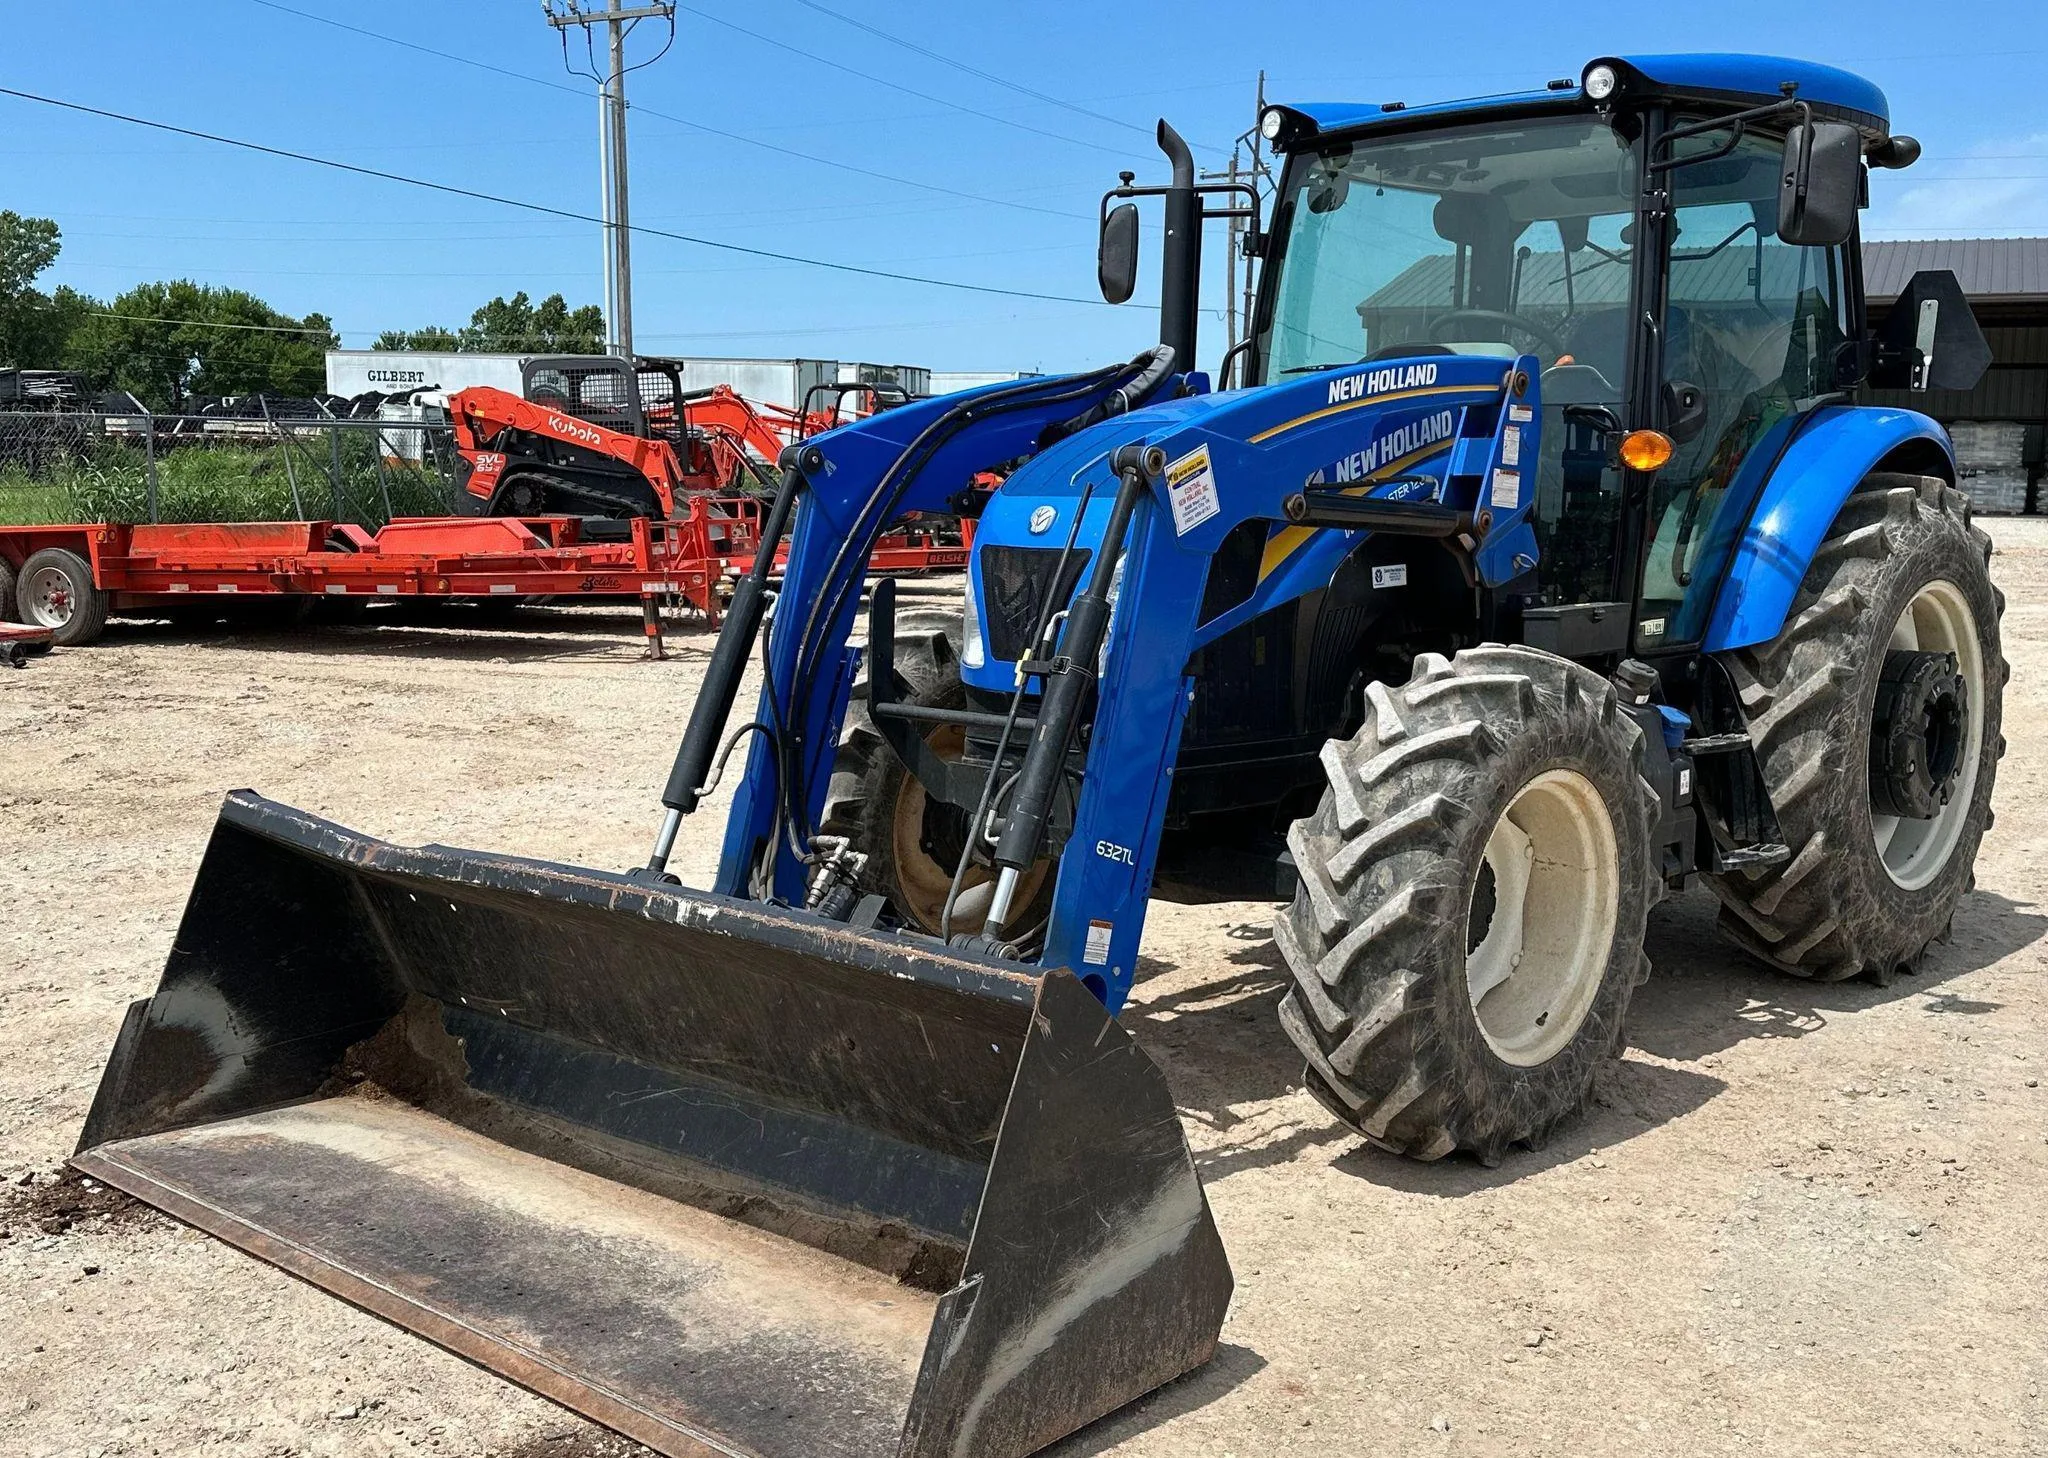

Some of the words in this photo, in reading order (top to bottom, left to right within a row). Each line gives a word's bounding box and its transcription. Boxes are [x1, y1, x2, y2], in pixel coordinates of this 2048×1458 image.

[367, 370, 425, 382] GILBERT
[1328, 374, 1366, 404] NEW
[1367, 363, 1437, 395] HOLLAND
[548, 415, 600, 445] Kubota
[476, 453, 504, 464] SVL
[1336, 441, 1377, 483] NEW
[1380, 410, 1452, 464] HOLLAND
[1096, 840, 1134, 866] 632TL
